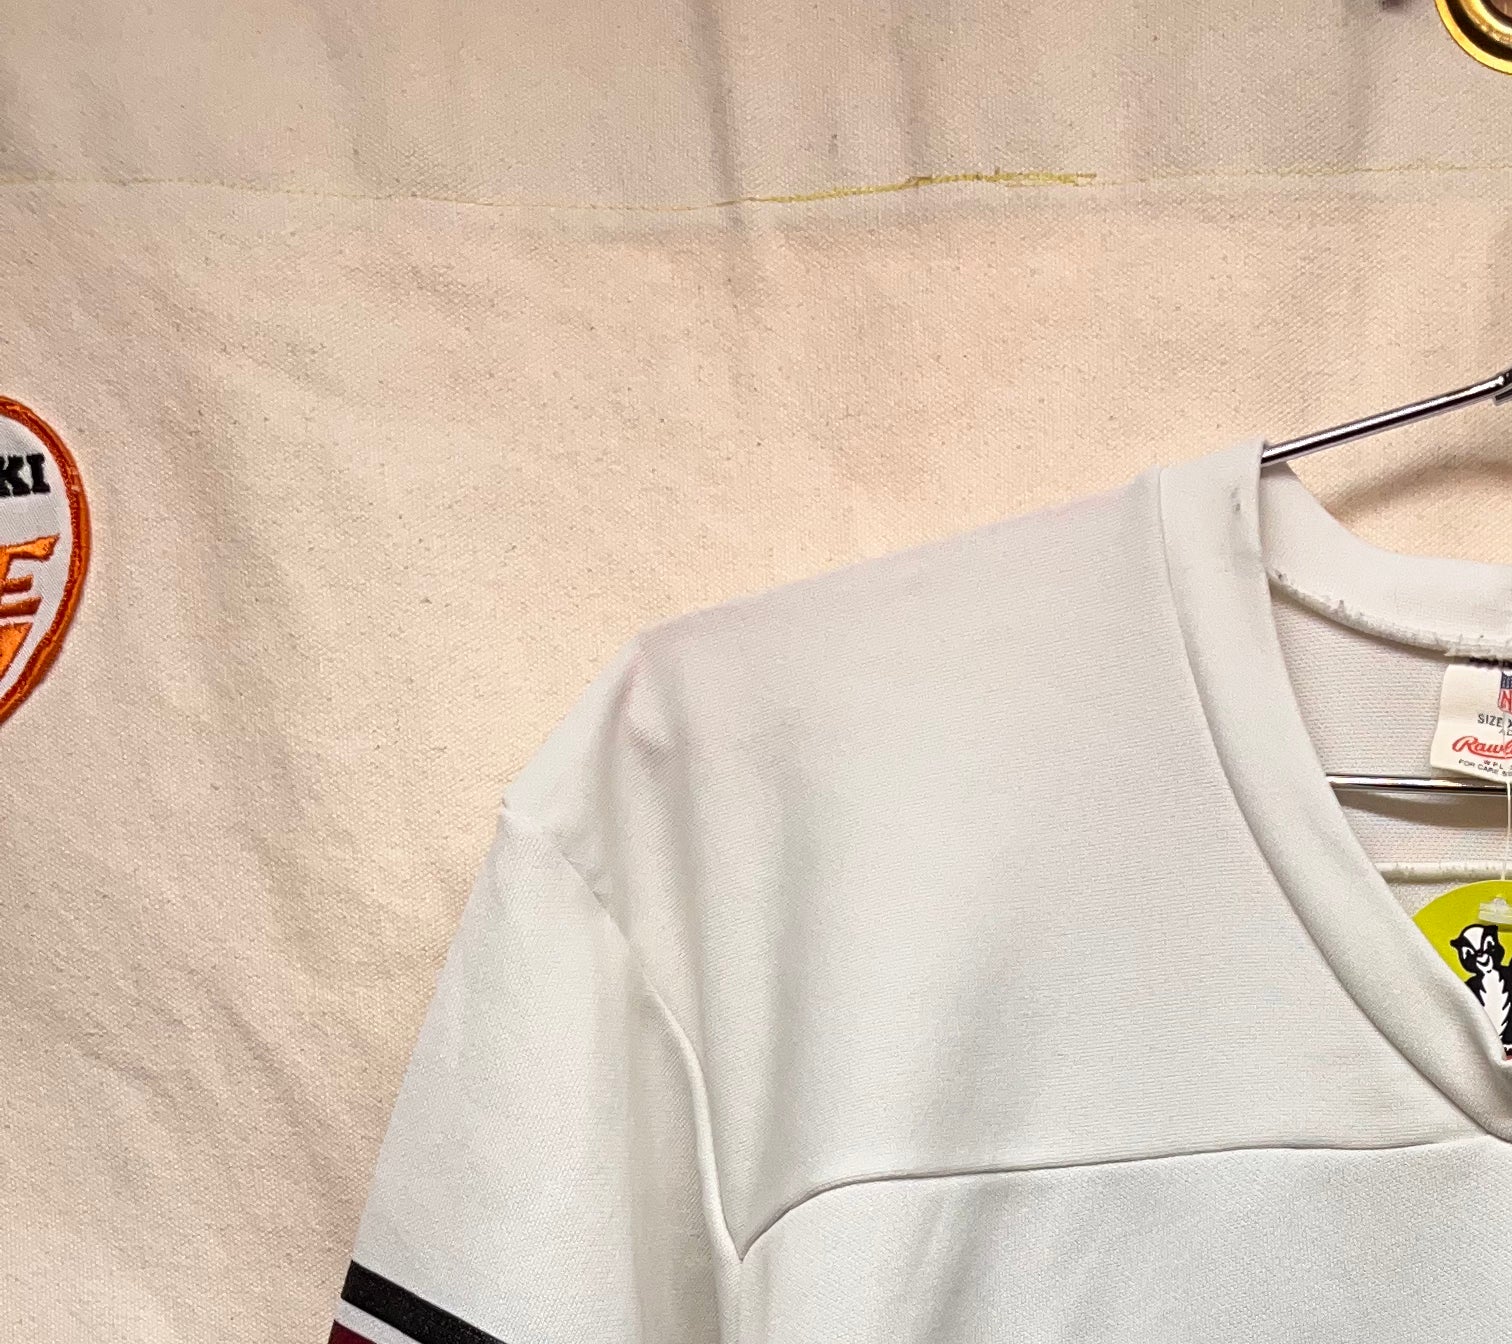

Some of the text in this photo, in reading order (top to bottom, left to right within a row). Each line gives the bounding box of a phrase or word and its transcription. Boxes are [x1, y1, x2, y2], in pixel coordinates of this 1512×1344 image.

[1477, 713, 1503, 729] SIZE
[1458, 758, 1475, 767] FOR
[1477, 764, 1499, 774] CARE
